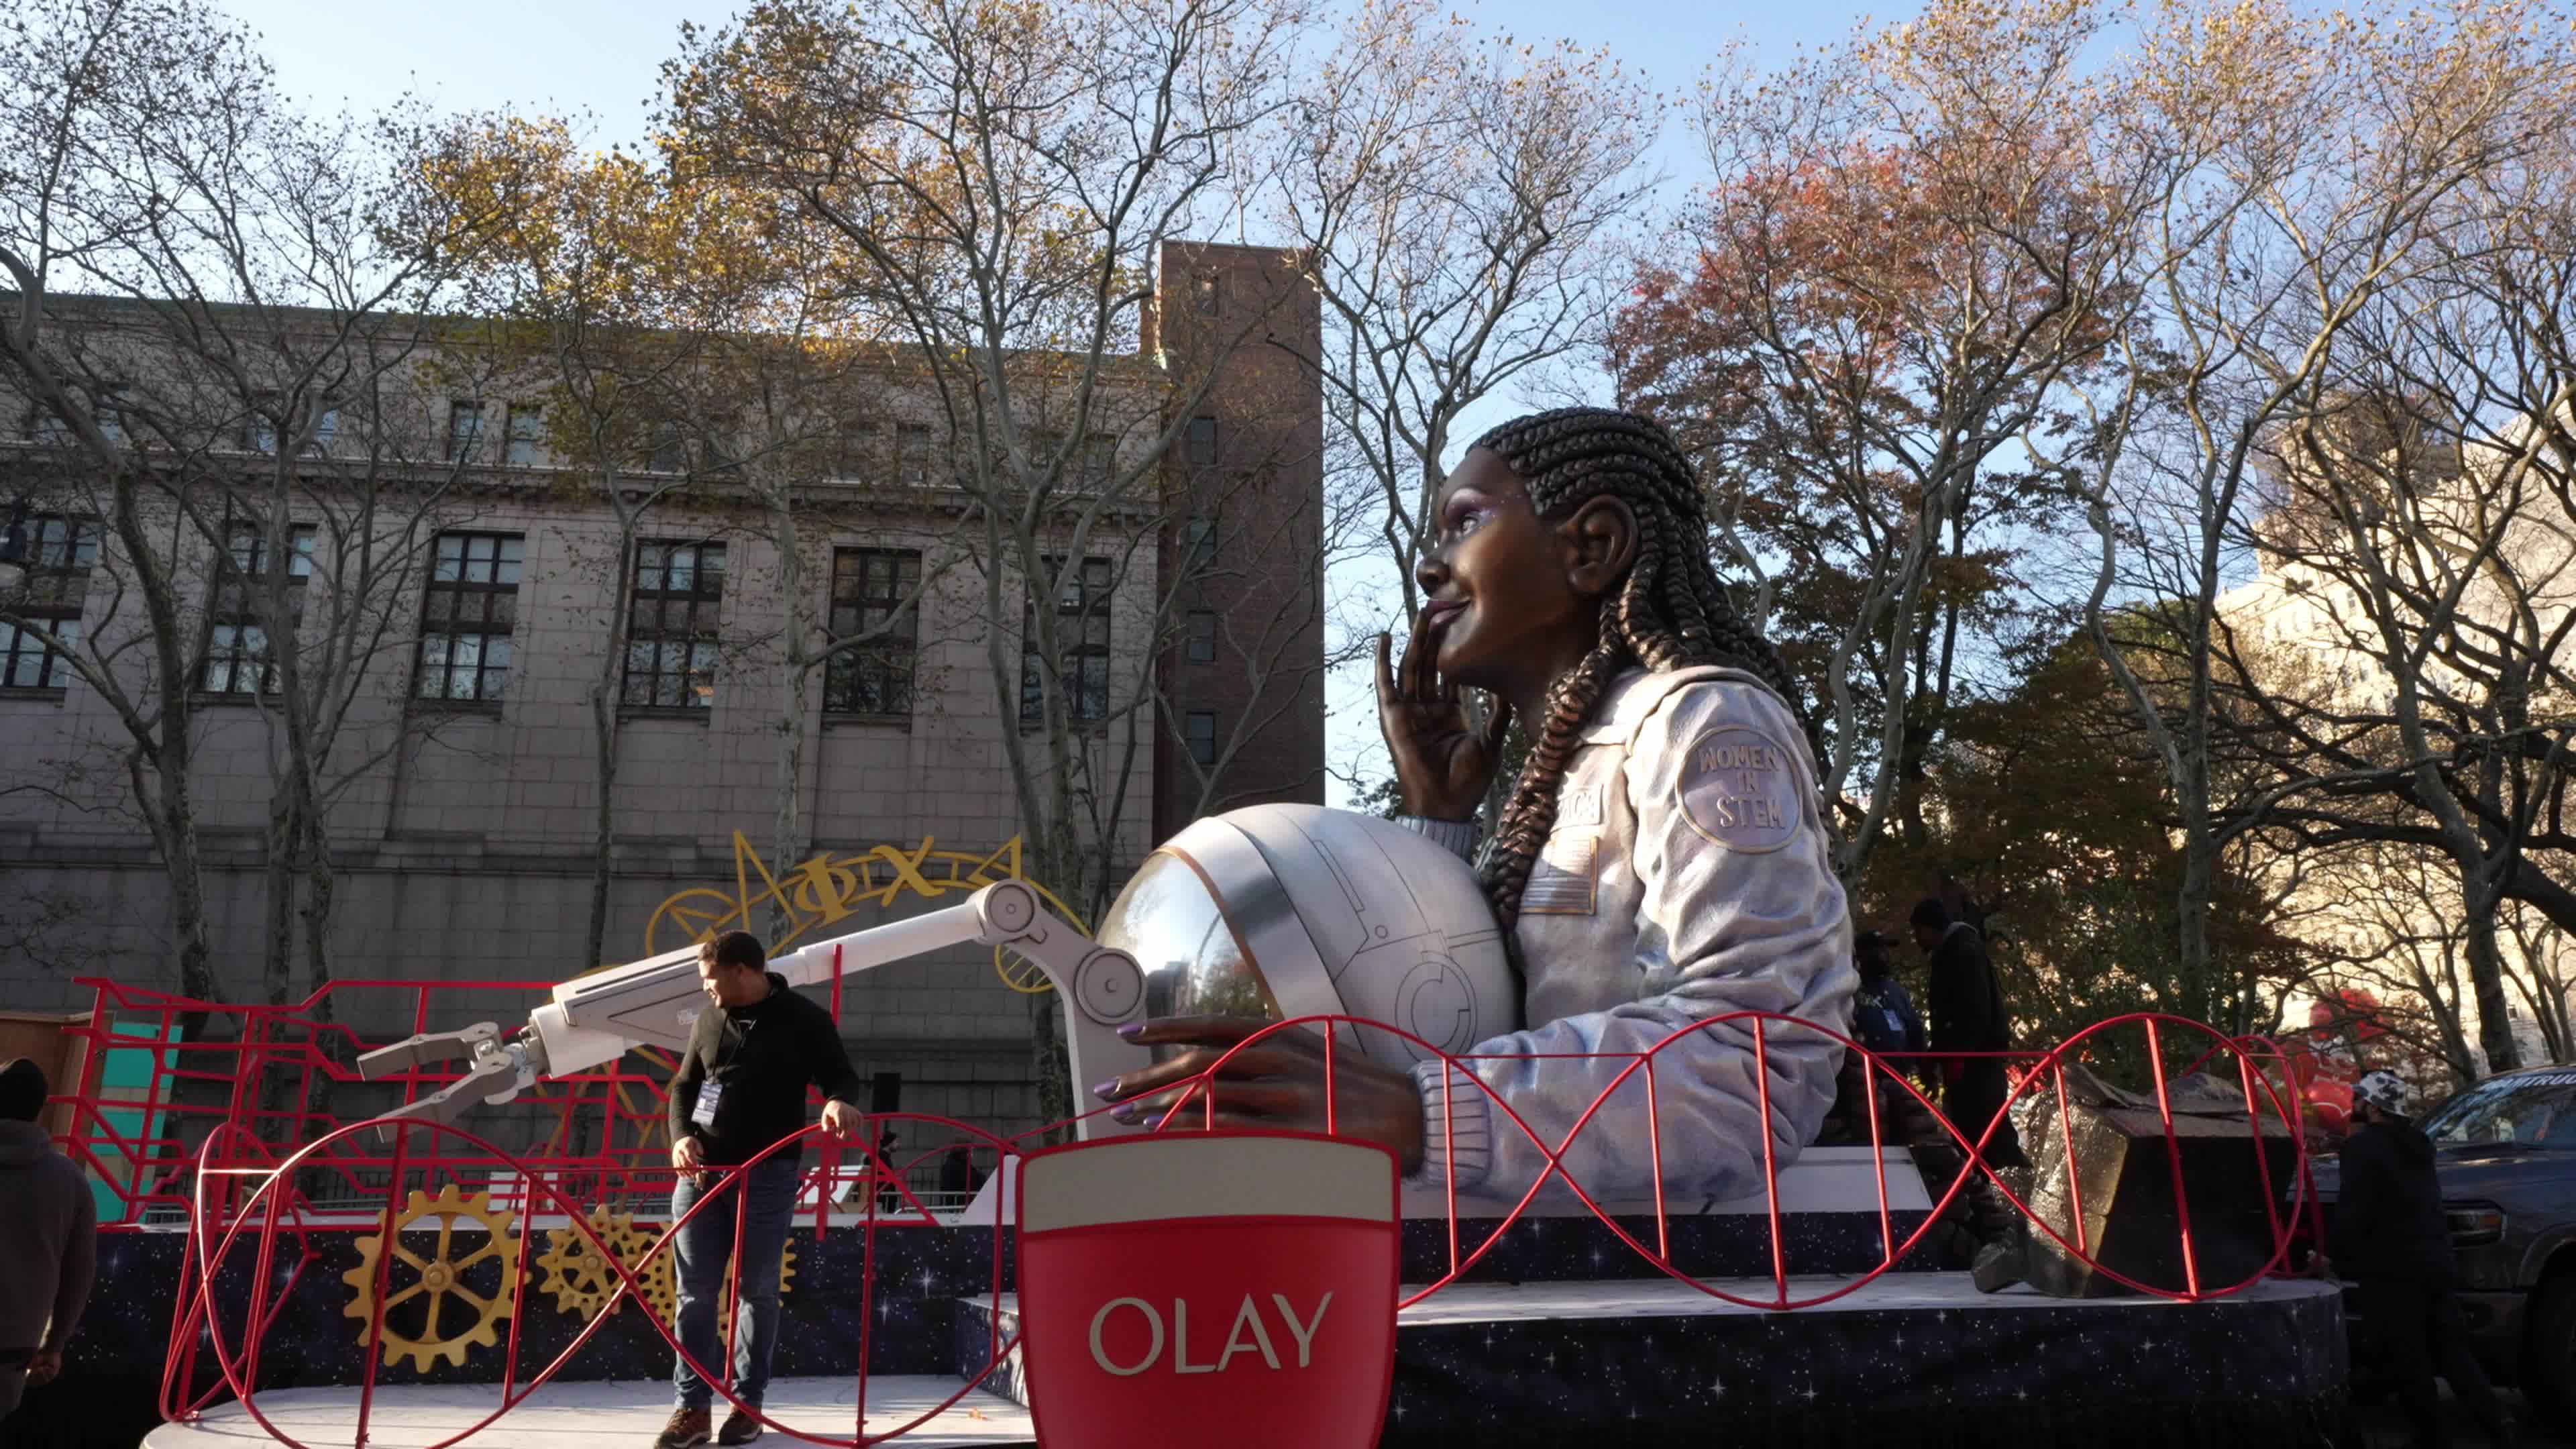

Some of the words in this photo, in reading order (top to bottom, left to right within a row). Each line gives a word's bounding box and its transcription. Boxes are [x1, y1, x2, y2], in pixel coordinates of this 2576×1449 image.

[1699, 745, 1779, 772] WOMEN
[1737, 771, 1760, 794] IN
[1717, 795, 1785, 828] STEM
[1089, 1291, 1333, 1375] OLAY
